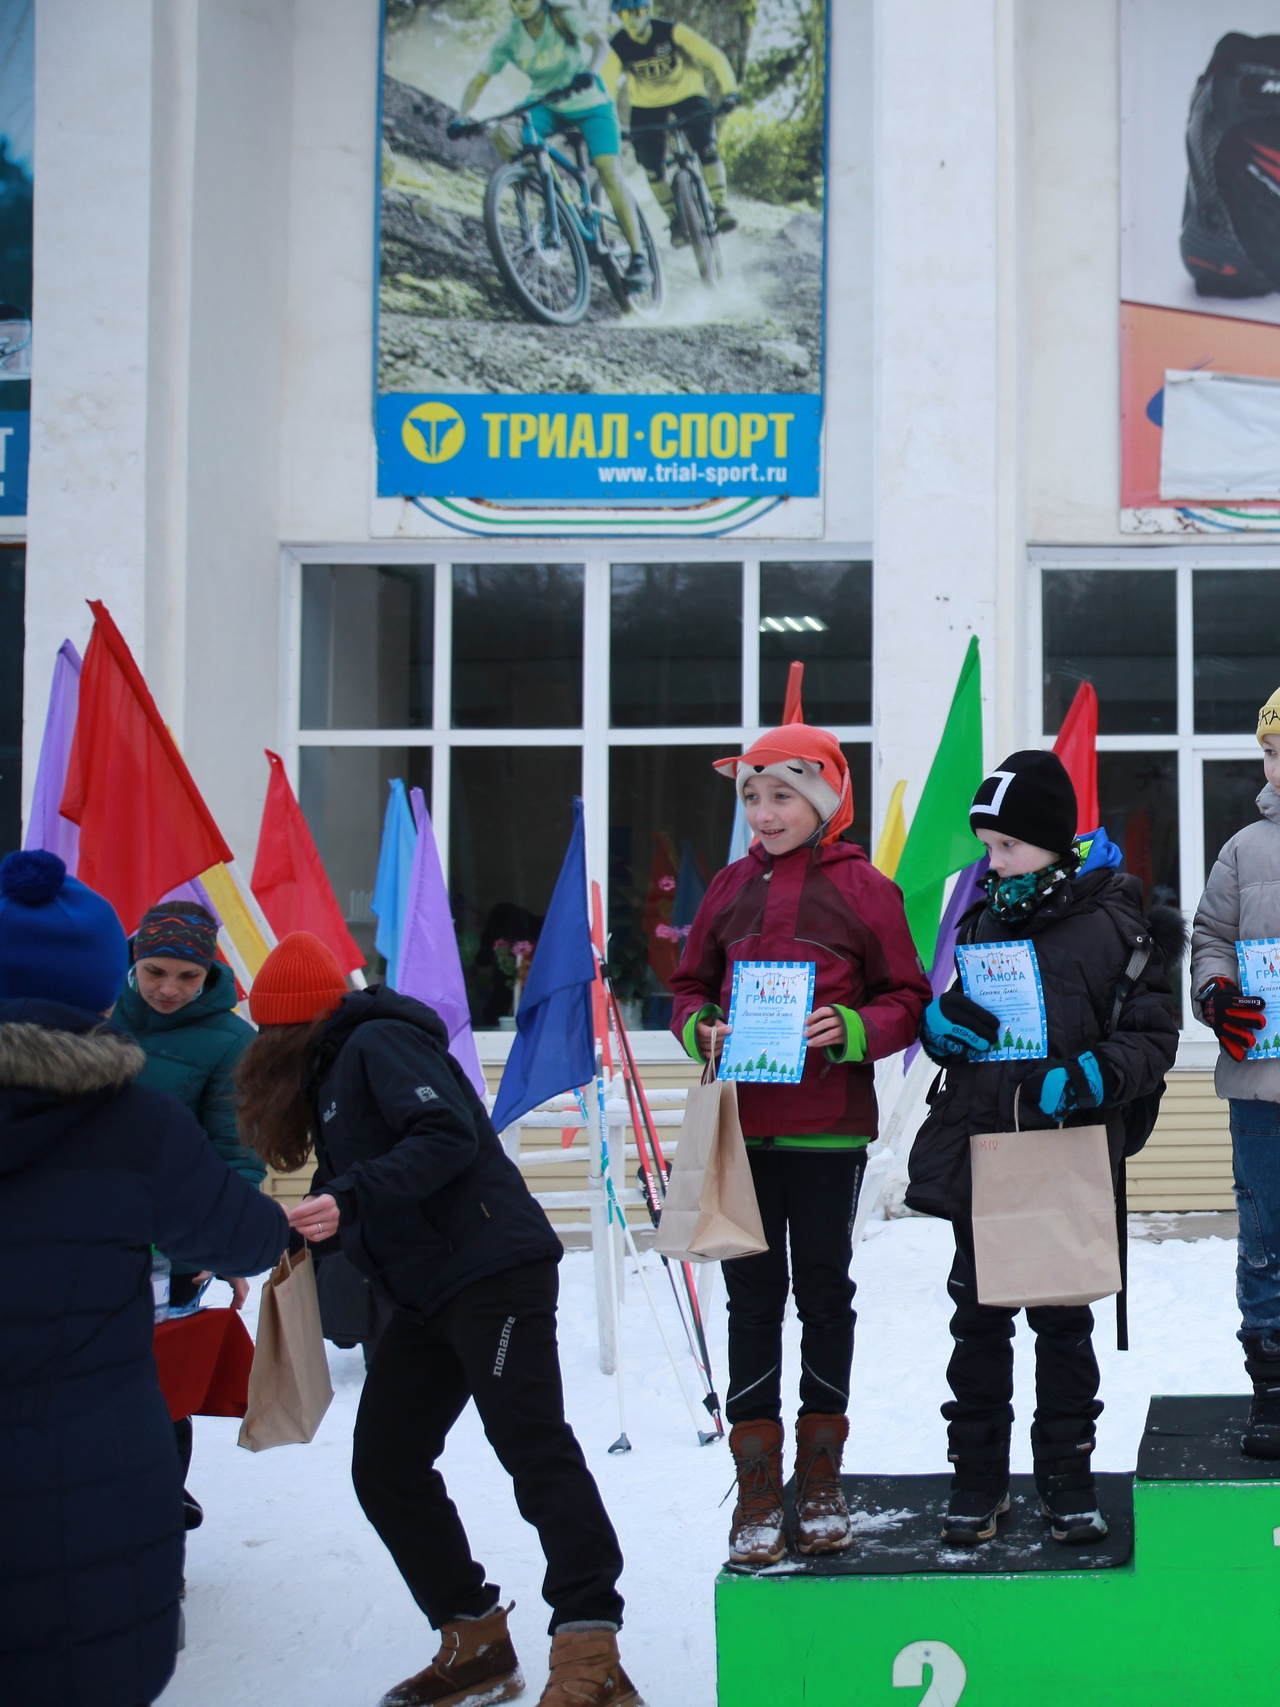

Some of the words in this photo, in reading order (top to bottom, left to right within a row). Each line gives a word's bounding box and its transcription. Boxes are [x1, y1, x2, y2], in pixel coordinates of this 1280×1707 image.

[598, 463, 788, 486] www.trial-sport.ru
[975, 971, 1026, 983] ГРАМОТА
[745, 994, 798, 1004] ГРАМОТА
[646, 1172, 662, 1211] NORDWAY
[493, 1315, 516, 1377] noname
